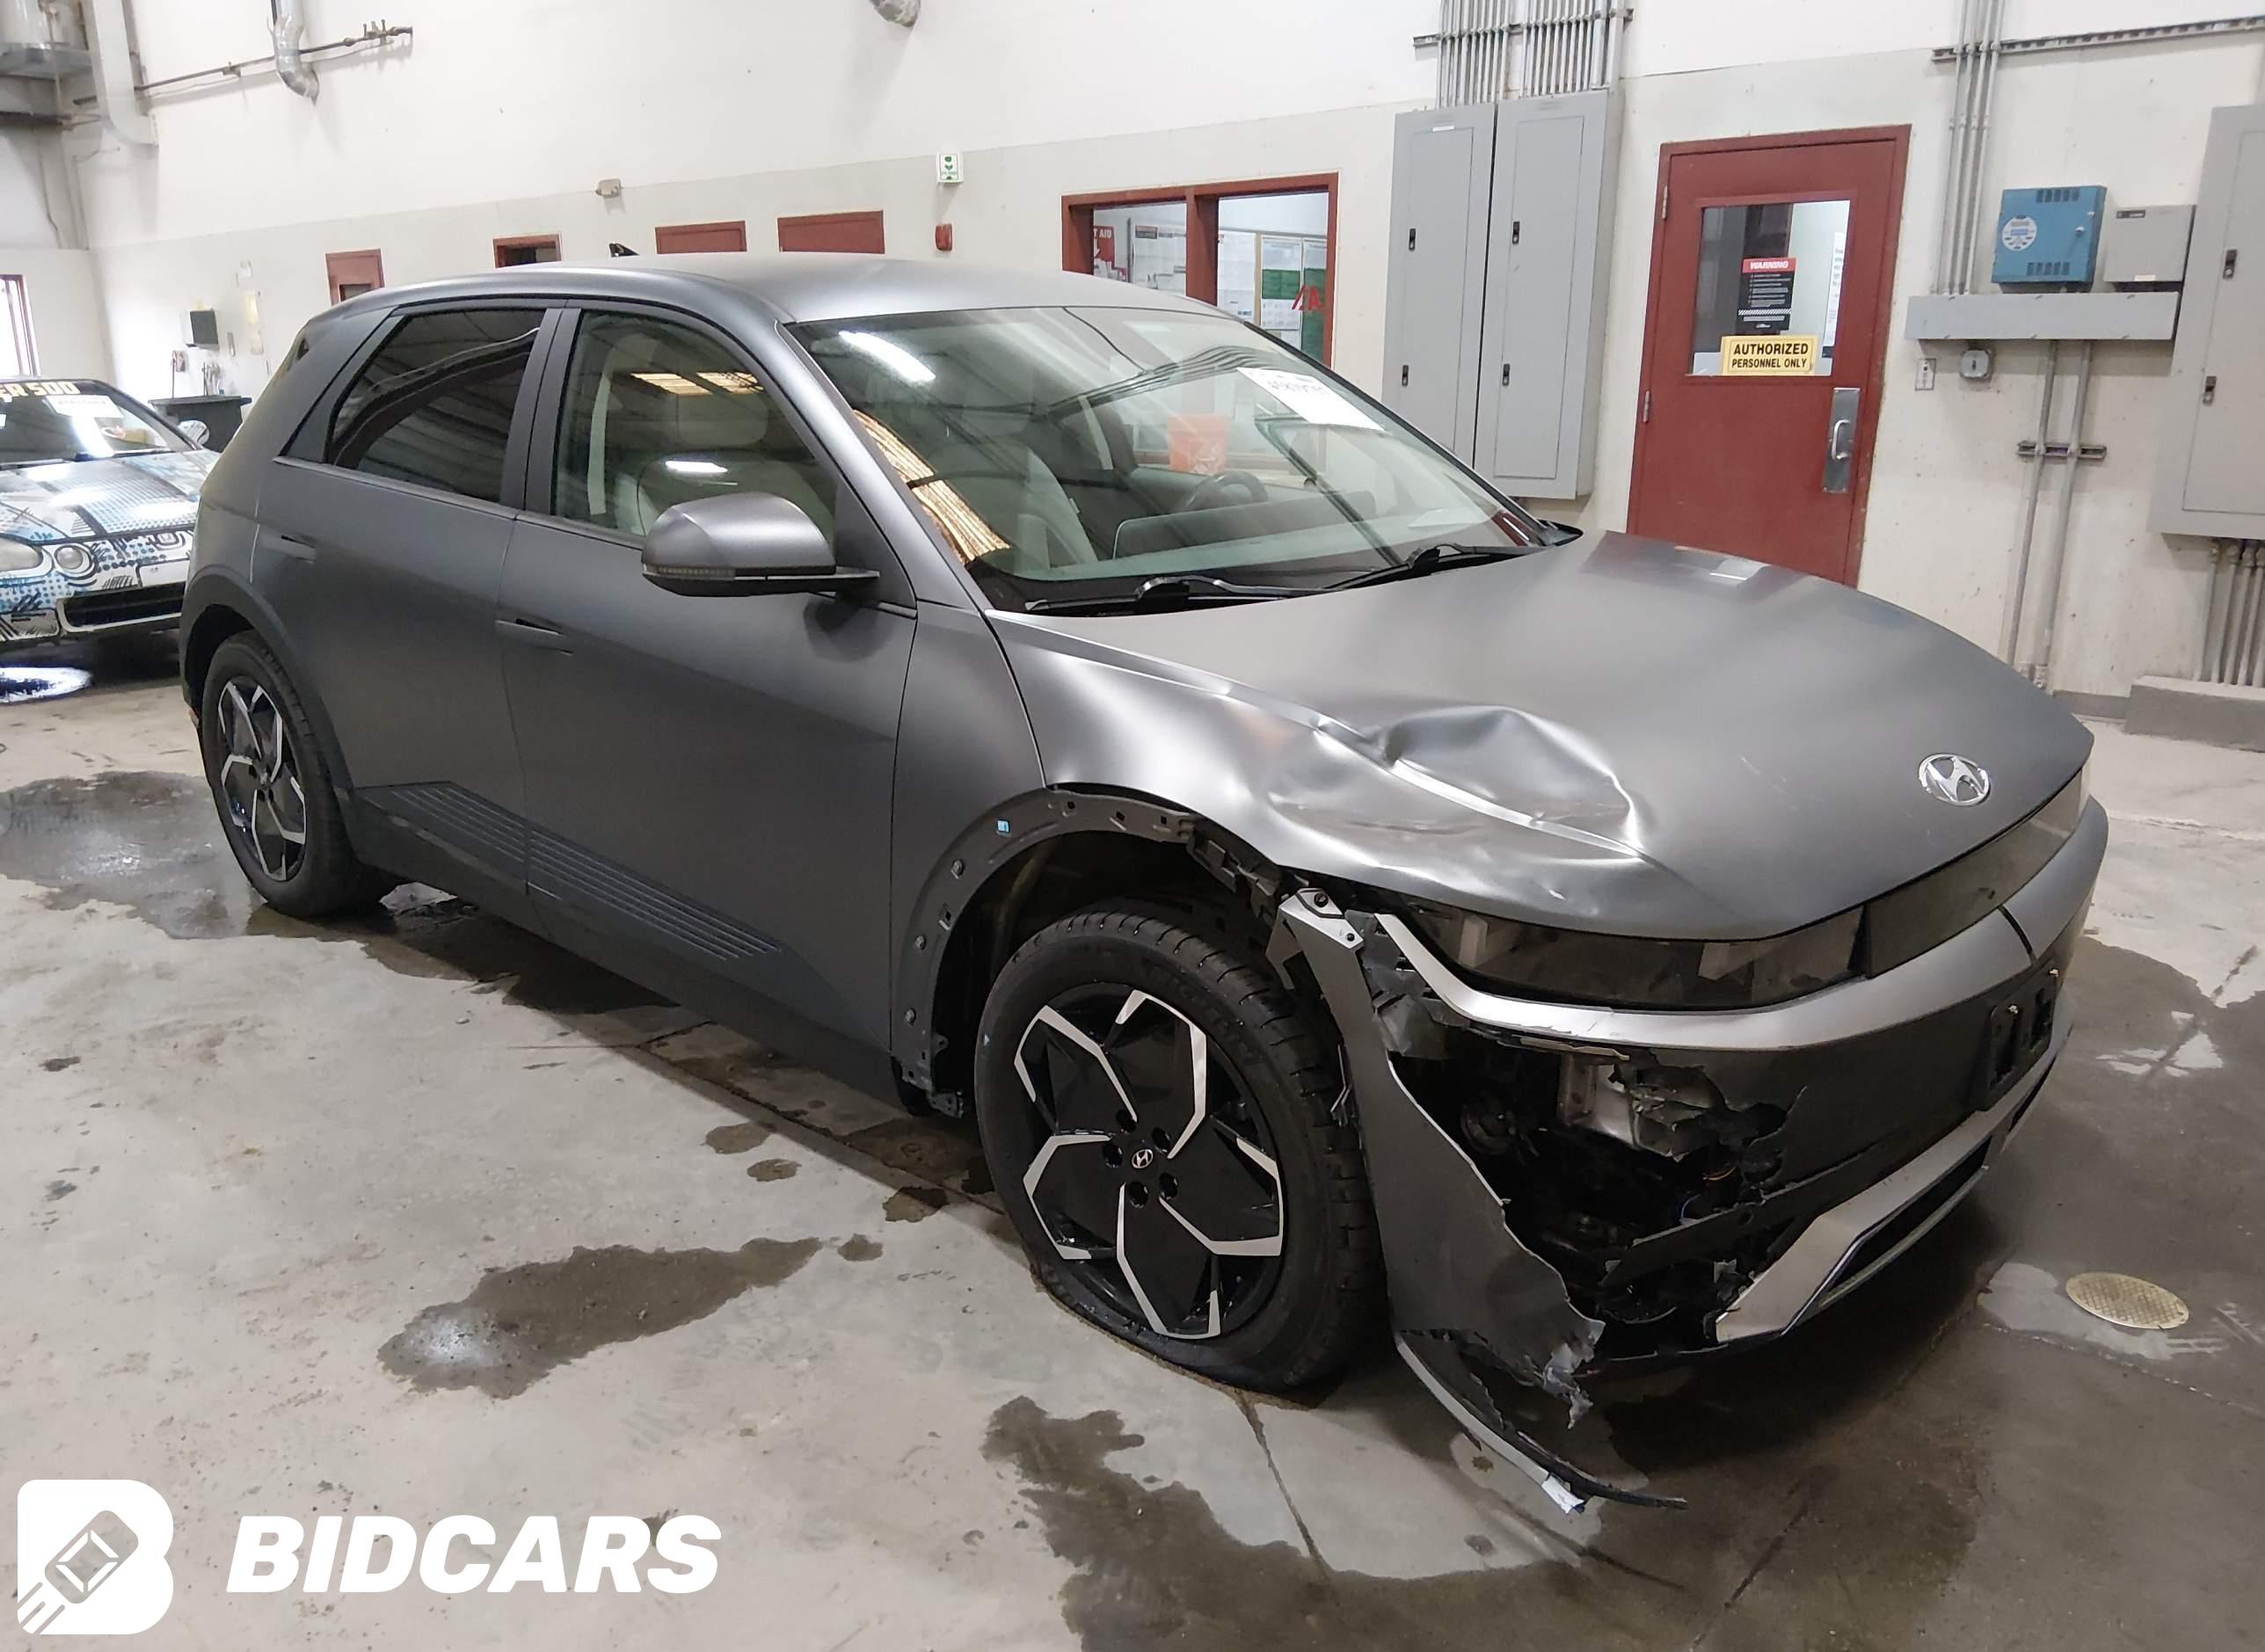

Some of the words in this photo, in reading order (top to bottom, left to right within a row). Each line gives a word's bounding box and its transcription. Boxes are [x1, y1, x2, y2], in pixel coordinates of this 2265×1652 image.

[1099, 229, 1111, 238] AID
[1734, 343, 1809, 355] AUTHORIZED
[1731, 358, 1781, 368] PERSONNEL
[1784, 358, 1808, 368] ONLY
